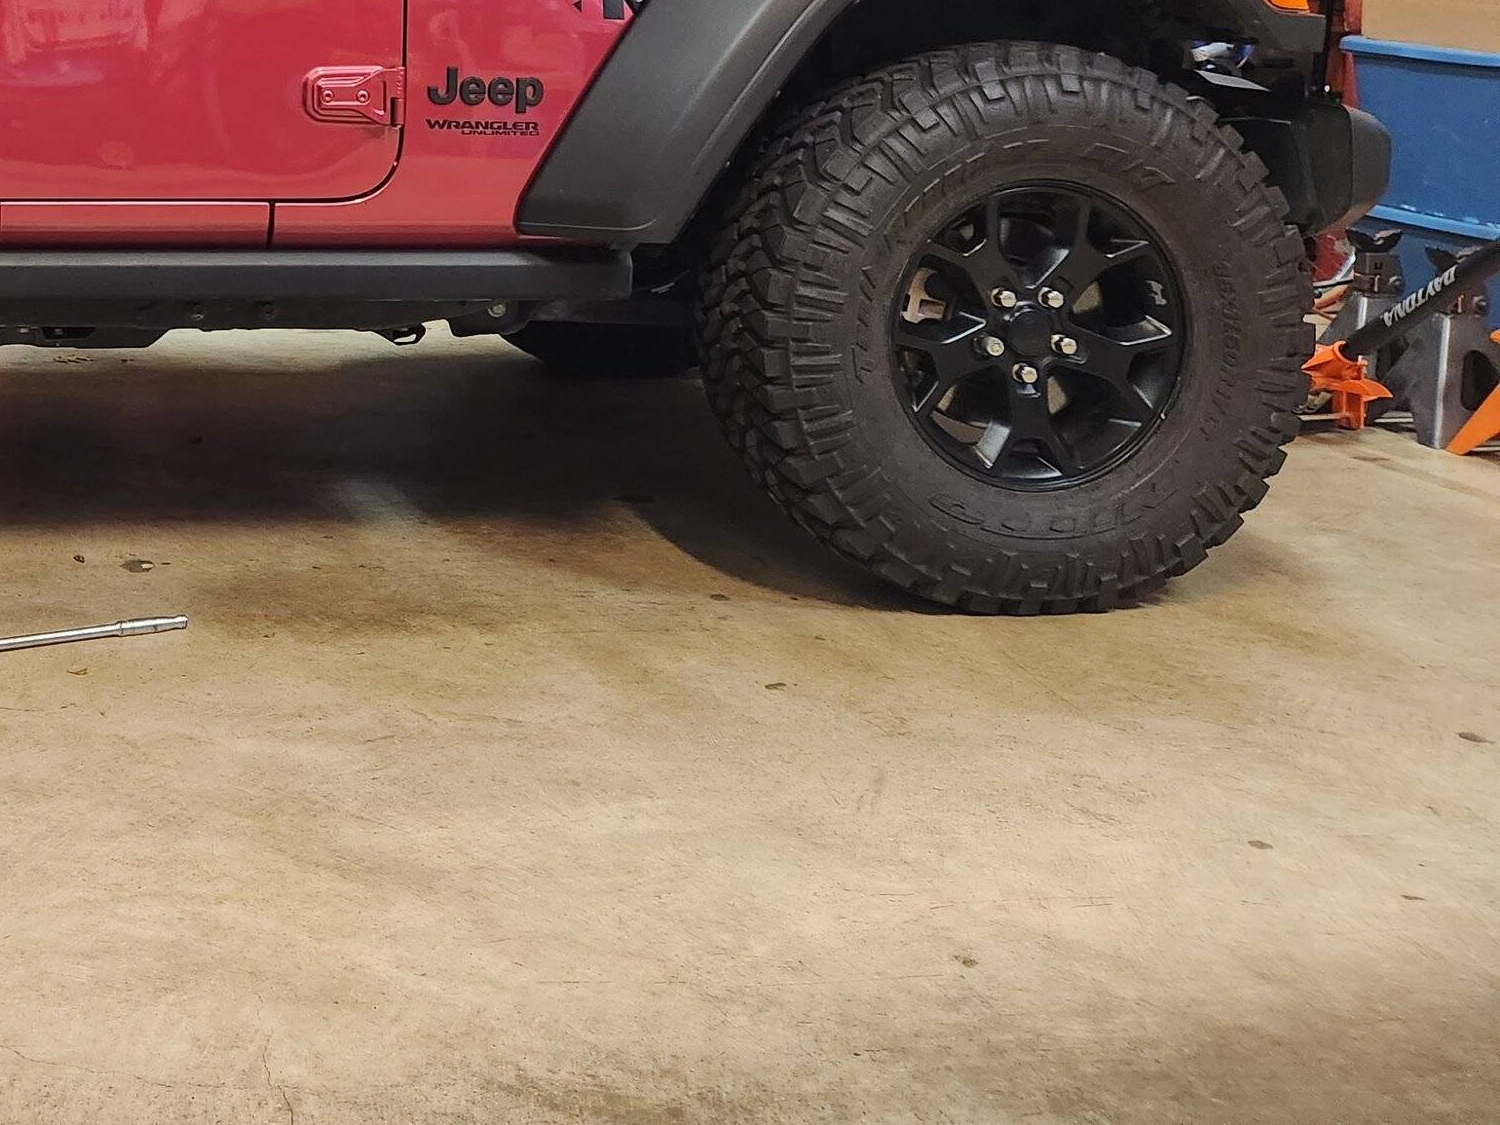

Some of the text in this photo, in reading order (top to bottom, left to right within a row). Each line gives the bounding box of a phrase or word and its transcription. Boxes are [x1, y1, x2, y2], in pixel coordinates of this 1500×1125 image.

[426, 66, 545, 114] Jeep
[425, 118, 540, 131] WRANGLER
[1382, 264, 1459, 327] DAYTONA
